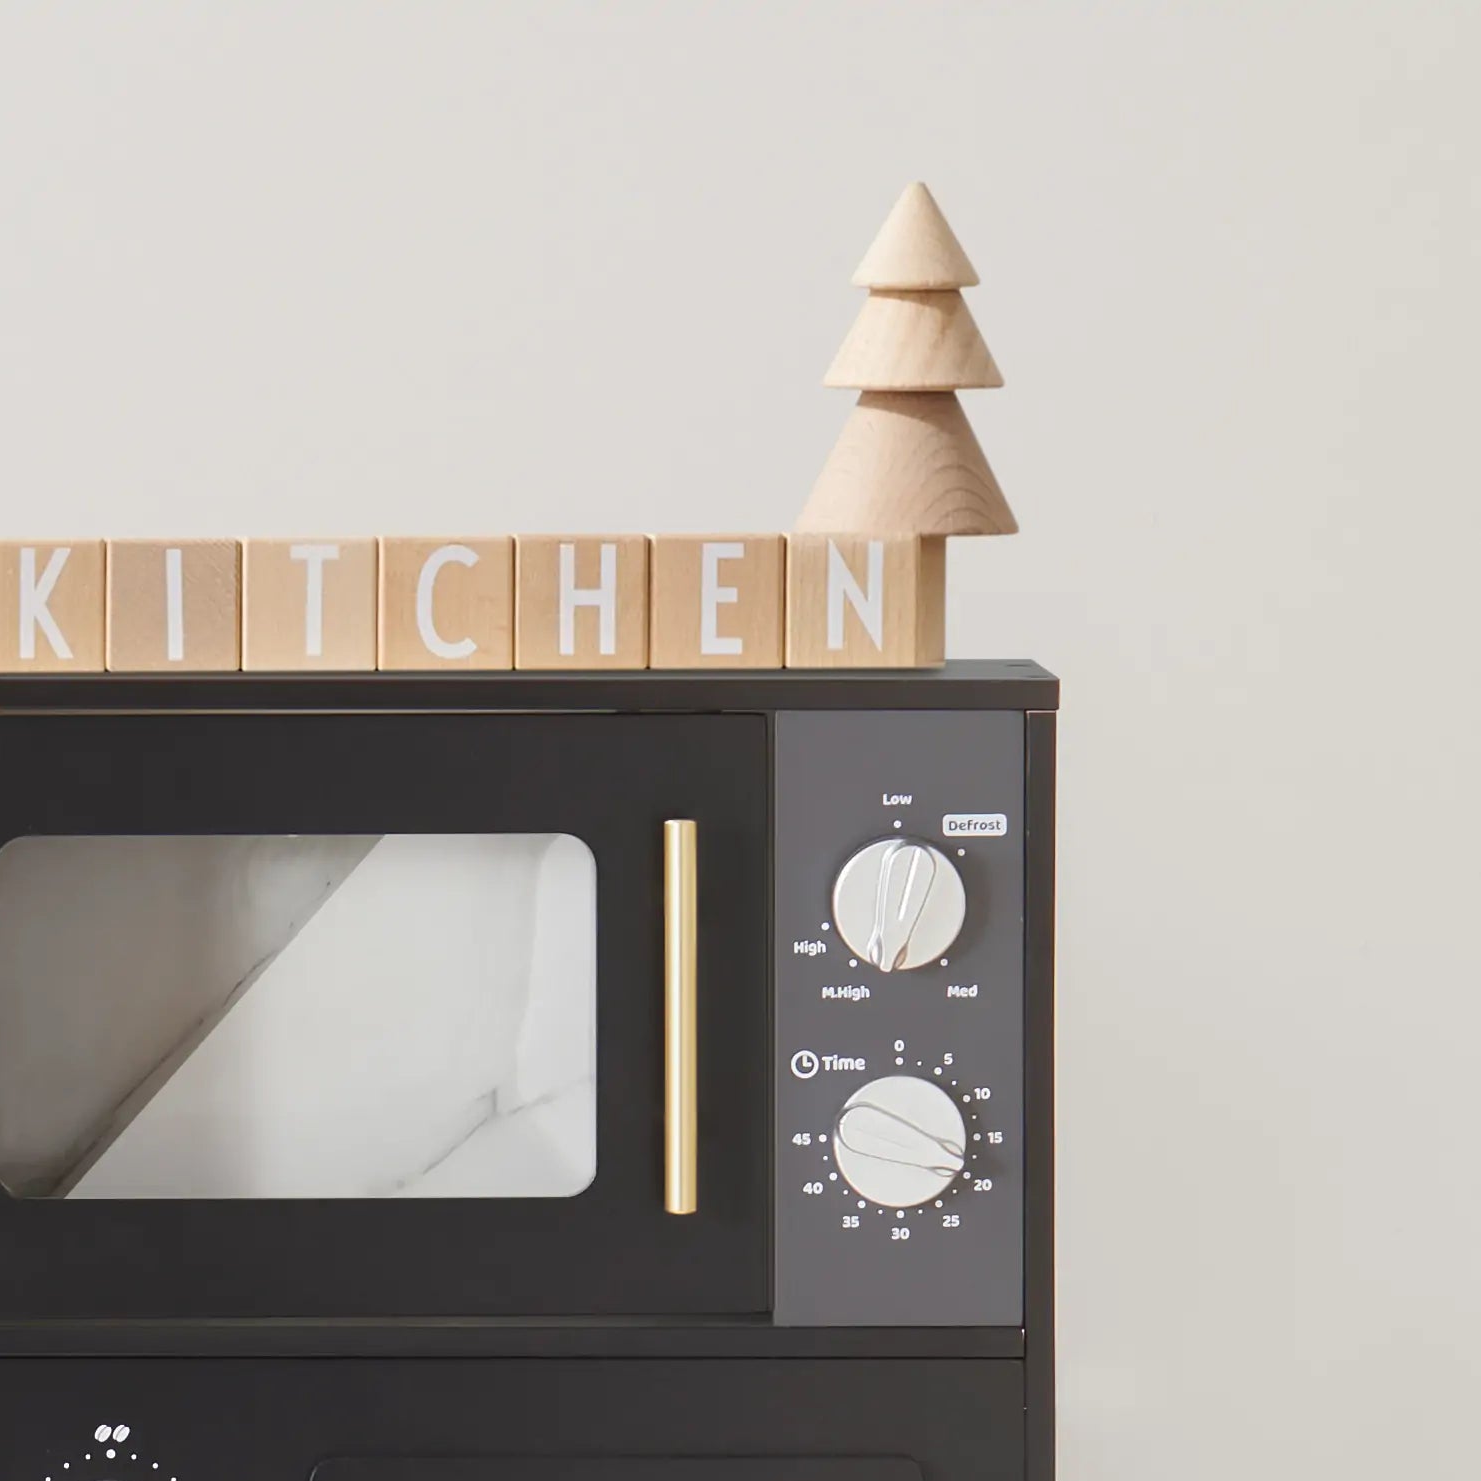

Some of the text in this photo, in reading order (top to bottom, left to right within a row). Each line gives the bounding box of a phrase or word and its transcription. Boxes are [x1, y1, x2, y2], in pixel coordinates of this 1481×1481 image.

[18, 540, 883, 660] KITCHEN
[882, 793, 913, 806] Low
[948, 819, 1001, 832] Defrost
[793, 940, 827, 957] High
[821, 984, 871, 1002] M.High
[946, 984, 978, 998] Med
[894, 1039, 905, 1052] 0
[821, 1054, 866, 1071] Time
[943, 1052, 954, 1066] 5
[973, 1087, 991, 1100] 10
[791, 1132, 812, 1146] 45
[987, 1131, 1003, 1144] 15
[802, 1181, 824, 1195] 40
[973, 1178, 993, 1192] 20
[842, 1215, 860, 1229] 35
[942, 1214, 960, 1228] 25
[891, 1227, 910, 1240] 30
